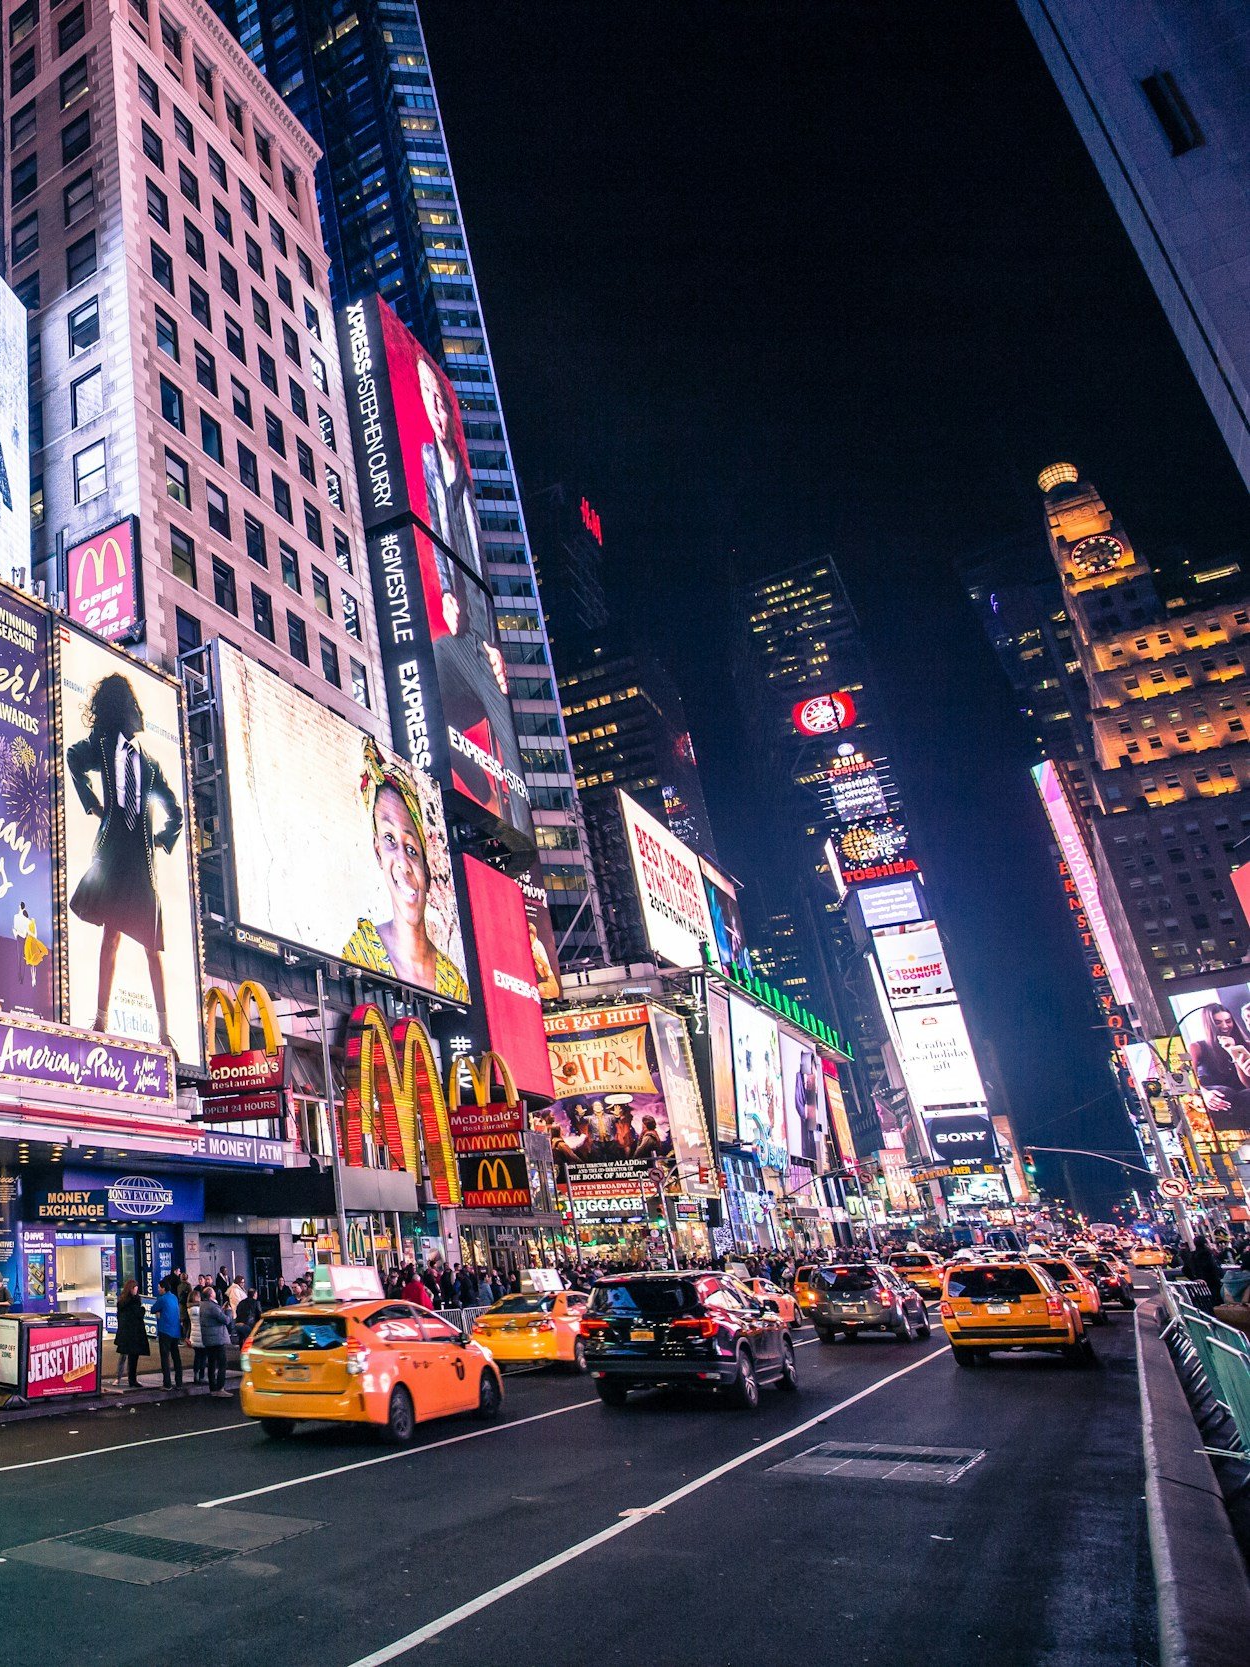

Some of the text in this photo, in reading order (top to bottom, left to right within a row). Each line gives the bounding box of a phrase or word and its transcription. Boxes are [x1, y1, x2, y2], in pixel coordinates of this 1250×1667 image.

[368, 452, 393, 508] CURRY
[79, 582, 124, 612] OPEN
[85, 598, 119, 629] 24
[381, 534, 432, 771] #GIVESTYLE EXPRESS
[827, 761, 874, 777] TOSHIBA
[832, 776, 878, 793] TOSHIBA
[634, 822, 664, 872] BEST
[842, 860, 918, 883] TOSHIBA
[1062, 834, 1109, 934] #HYATTALLIN
[1058, 860, 1092, 946] ERNST
[901, 962, 942, 974] DUNKIN'
[903, 969, 942, 980] DONUTS
[891, 986, 920, 995] HOT
[573, 1014, 601, 1030] FAT
[773, 988, 840, 1049] BROADWAY
[916, 1037, 956, 1050] Crafted
[0, 1027, 82, 1084] American
[81, 1065, 91, 1075] in
[86, 1047, 128, 1090] Paris
[210, 1061, 279, 1080] cDonald's
[212, 1077, 265, 1090] Restaurant
[205, 1101, 276, 1114] OPEN 24 HOURS
[451, 1111, 519, 1125] McDonald's
[463, 1122, 509, 1131] Restaurant
[936, 1131, 986, 1143] SONY
[210, 1139, 282, 1160] MONEY ATM
[47, 1192, 91, 1203] MONEY
[134, 1189, 173, 1203] EXCHANGE
[39, 1205, 104, 1216] EXCHANGE
[28, 1346, 70, 1383] JERSEY
[72, 1338, 98, 1369] BOYS
